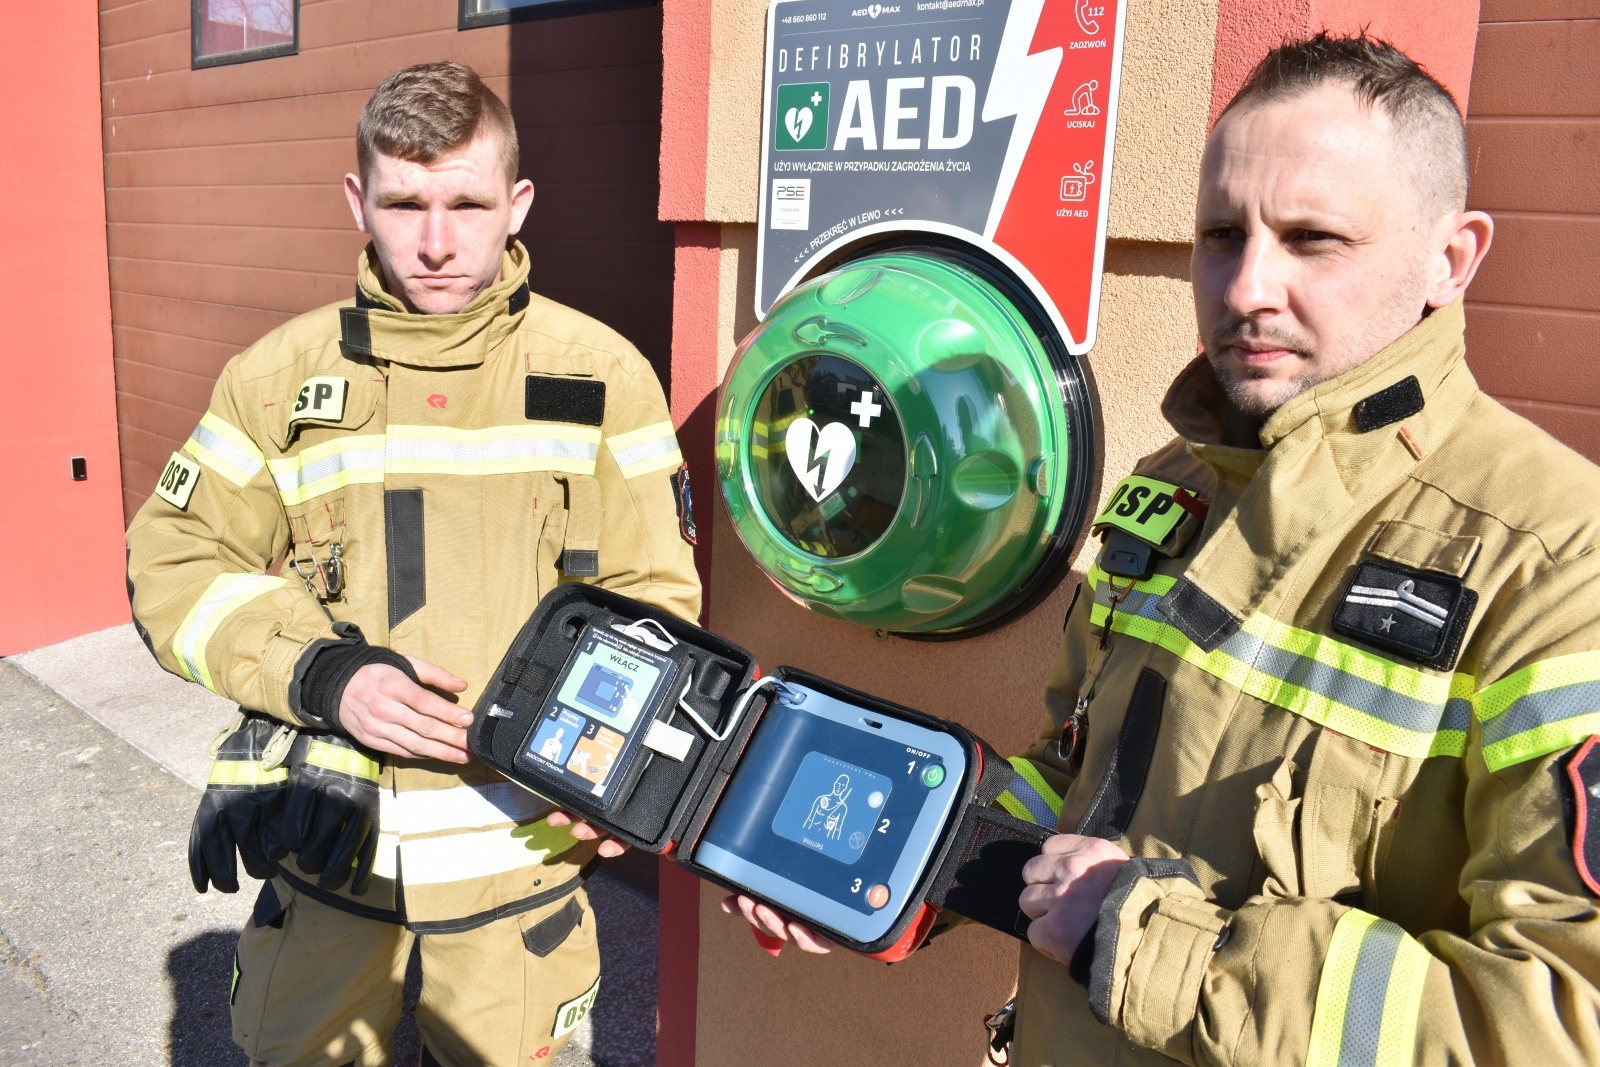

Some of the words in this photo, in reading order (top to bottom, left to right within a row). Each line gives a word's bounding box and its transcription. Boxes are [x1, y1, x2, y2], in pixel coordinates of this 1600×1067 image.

[793, 14, 804, 23] 660
[818, 12, 827, 21] 112
[851, 8, 867, 17] AED
[882, 5, 901, 14] MAX
[1088, 6, 1105, 17] 112
[1069, 38, 1107, 50] ZADZWOŃ
[778, 34, 982, 73] DEFIBRYLATOR
[833, 75, 976, 151] AED
[1066, 120, 1095, 129] UCISKAJ
[774, 159, 791, 172] UŻYJ
[792, 161, 834, 173] WYŁĄCZNIE
[834, 161, 843, 172] W
[843, 161, 890, 172] PRZYPADKU
[891, 158, 945, 172] ZAGROŻENIA
[946, 158, 971, 172] ŻYCIA
[776, 186, 805, 197] PSE
[1056, 208, 1073, 217] UŻYJ
[1073, 209, 1089, 218] AED
[809, 219, 848, 250] PRZEKRĘĆ
[847, 216, 857, 228] W
[857, 209, 881, 224] LEWO
[294, 383, 333, 412] SP
[160, 460, 190, 495] OSP
[1101, 483, 1175, 525] OSP
[586, 641, 594, 651] 1
[609, 653, 640, 673] WŁĄCZ
[549, 706, 558, 718] 2
[586, 724, 595, 735] 3
[906, 747, 931, 759] ON/OFF
[907, 760, 917, 775] 1
[877, 818, 890, 834] 2
[802, 836, 824, 851] PHILIPS
[850, 878, 862, 893] 3
